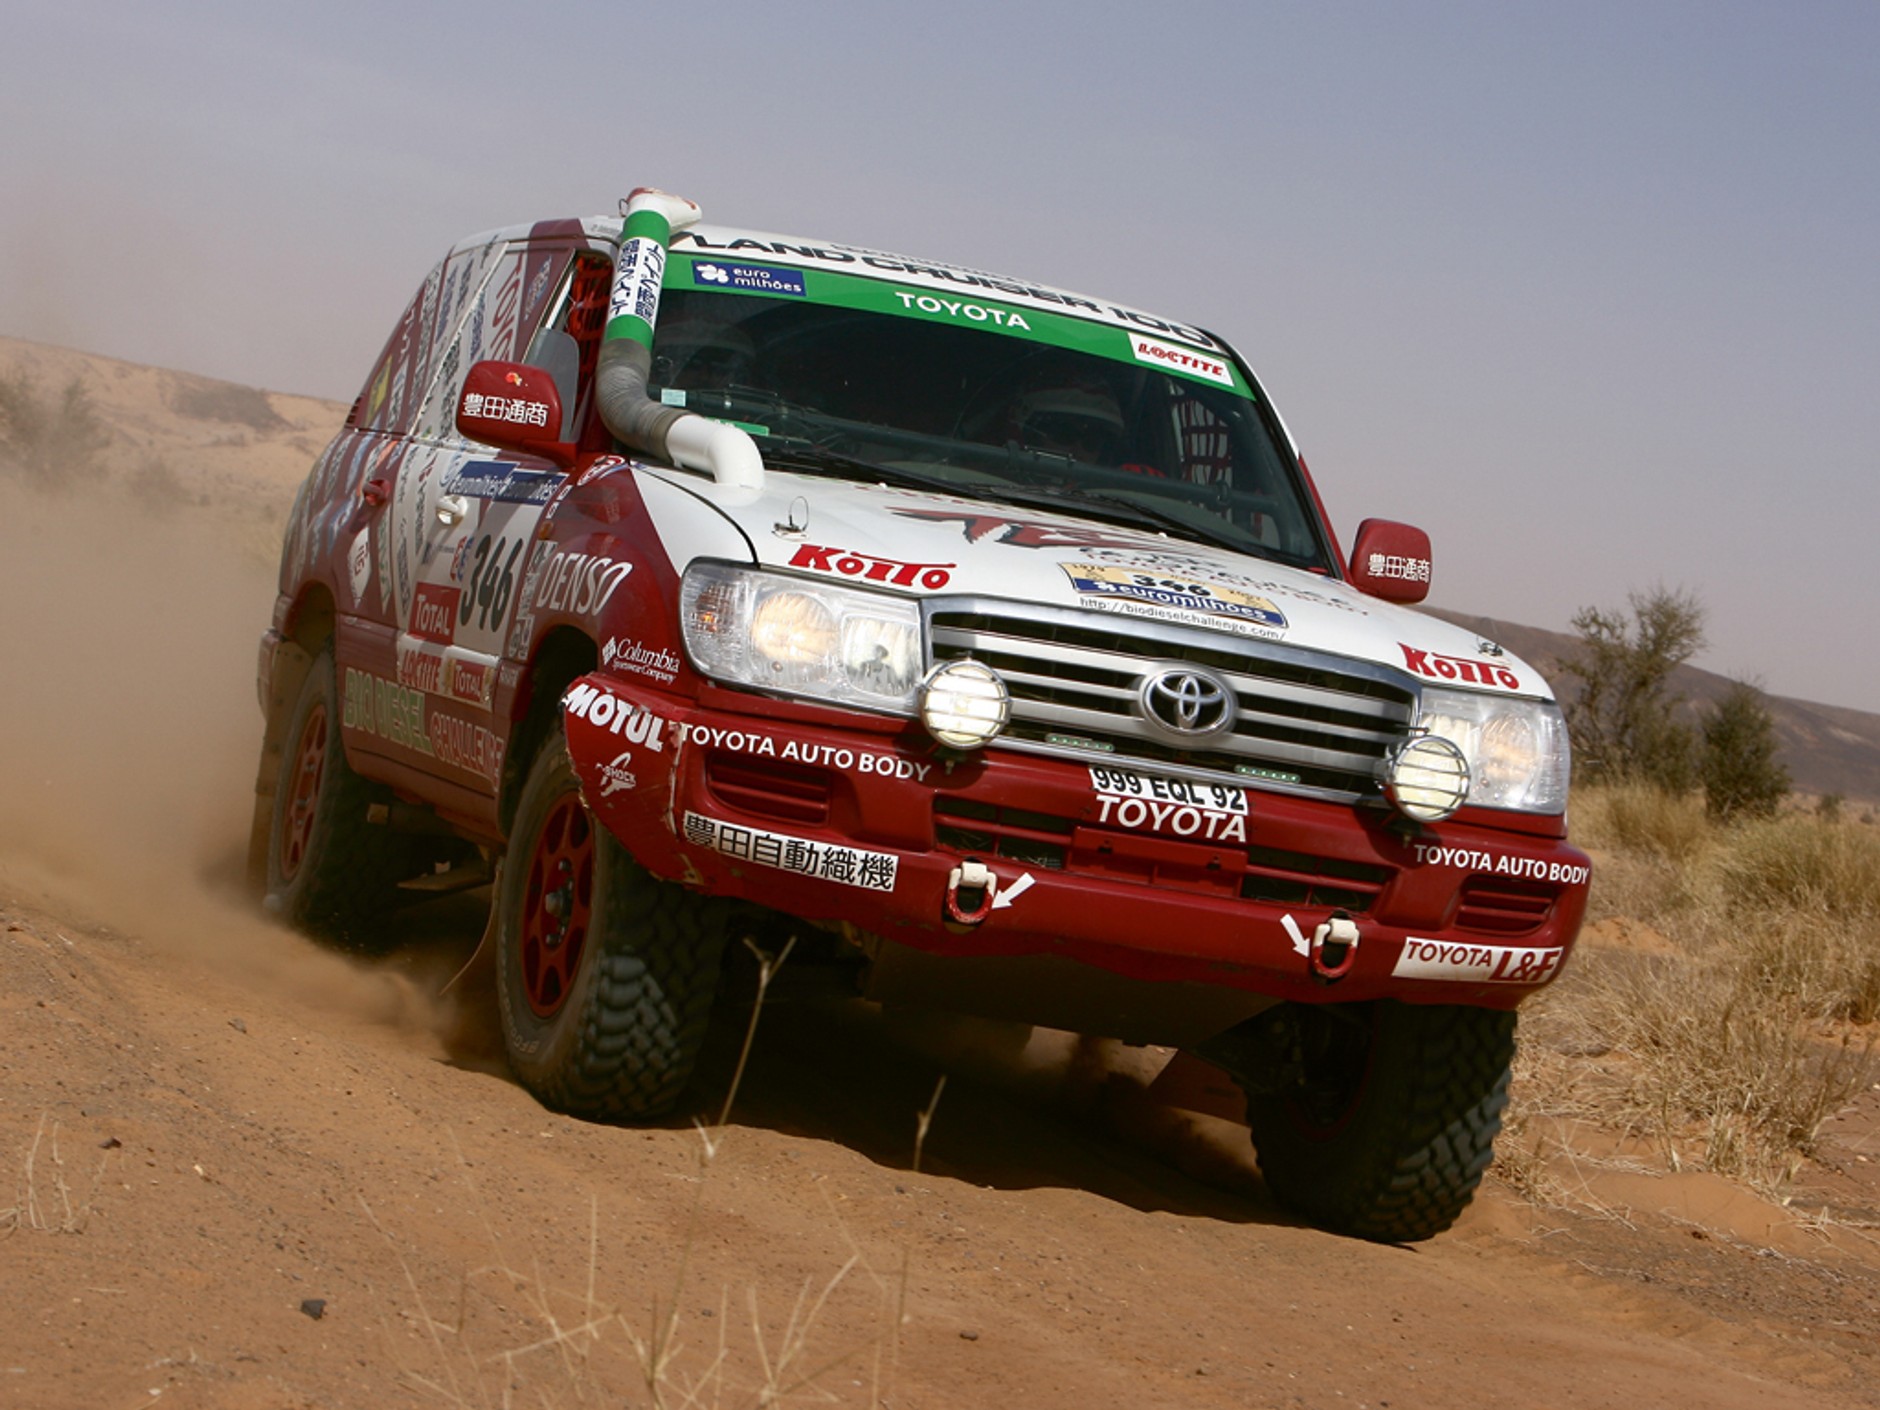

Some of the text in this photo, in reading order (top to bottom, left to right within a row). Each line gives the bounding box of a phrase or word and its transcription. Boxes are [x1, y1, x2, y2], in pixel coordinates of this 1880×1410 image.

[690, 231, 856, 263] LAND
[861, 256, 1103, 314] CRUISER
[1108, 306, 1214, 348] 100
[732, 267, 771, 280] euro
[733, 275, 802, 294] milhões
[895, 290, 1032, 332] TOYOTA
[1137, 342, 1223, 377] LOCTITE
[462, 393, 549, 427] 豊田通商
[460, 534, 524, 633] 346
[536, 551, 633, 616] DENSO
[1133, 574, 1211, 597] 346
[1367, 553, 1431, 583] 豊田通商
[1080, 597, 1286, 640] http://biodieselchallenge.com/
[617, 638, 680, 673] Columbia
[562, 683, 665, 753] MOTUL
[678, 721, 932, 783] TOYOTA AUTO BODY
[1092, 766, 1246, 812] 999 EQL 92
[1095, 794, 1247, 843] TOYOTA
[1413, 843, 1590, 885] TOYOTA AUTO BODY
[1406, 940, 1561, 983] TOYOTA L&F
